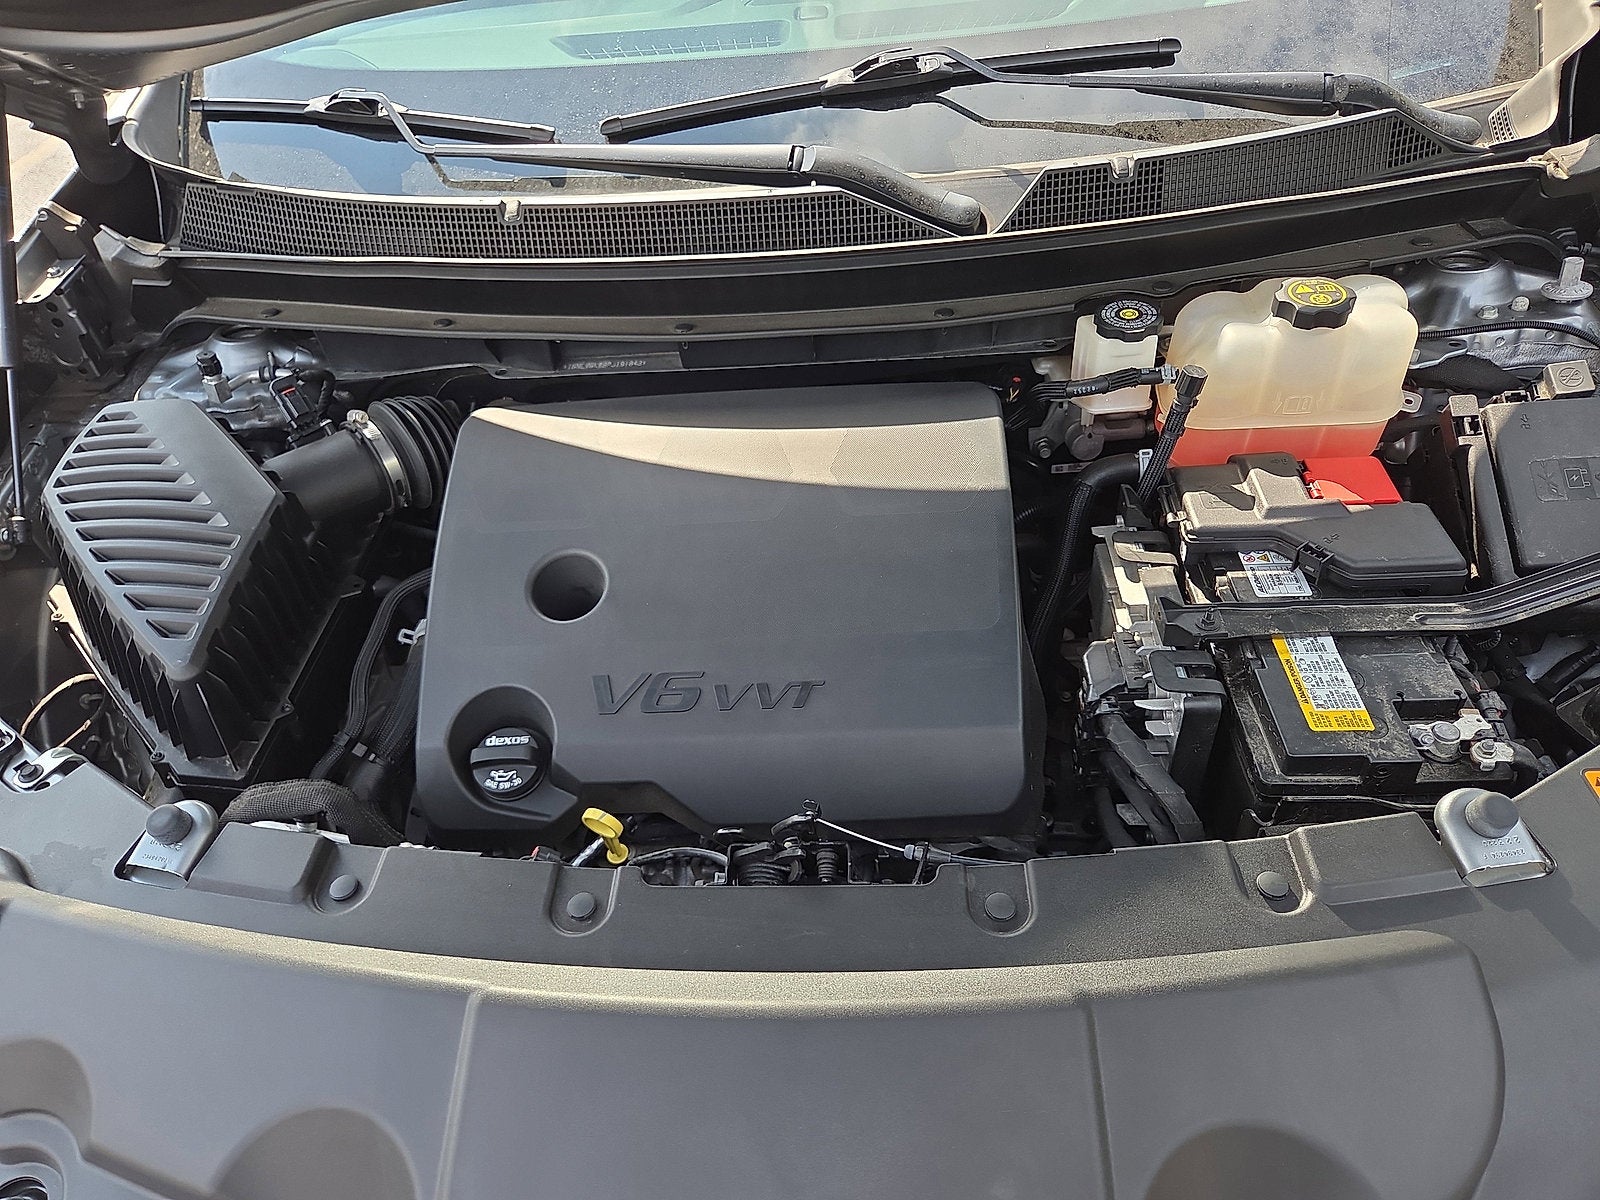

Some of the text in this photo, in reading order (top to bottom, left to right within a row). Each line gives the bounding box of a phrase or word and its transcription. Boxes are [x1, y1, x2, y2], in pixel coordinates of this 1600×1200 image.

[1284, 658, 1307, 699] DANGER POISON
[591, 671, 825, 715] V6 VVT
[485, 735, 531, 747] dexos
[484, 778, 499, 789] SAE
